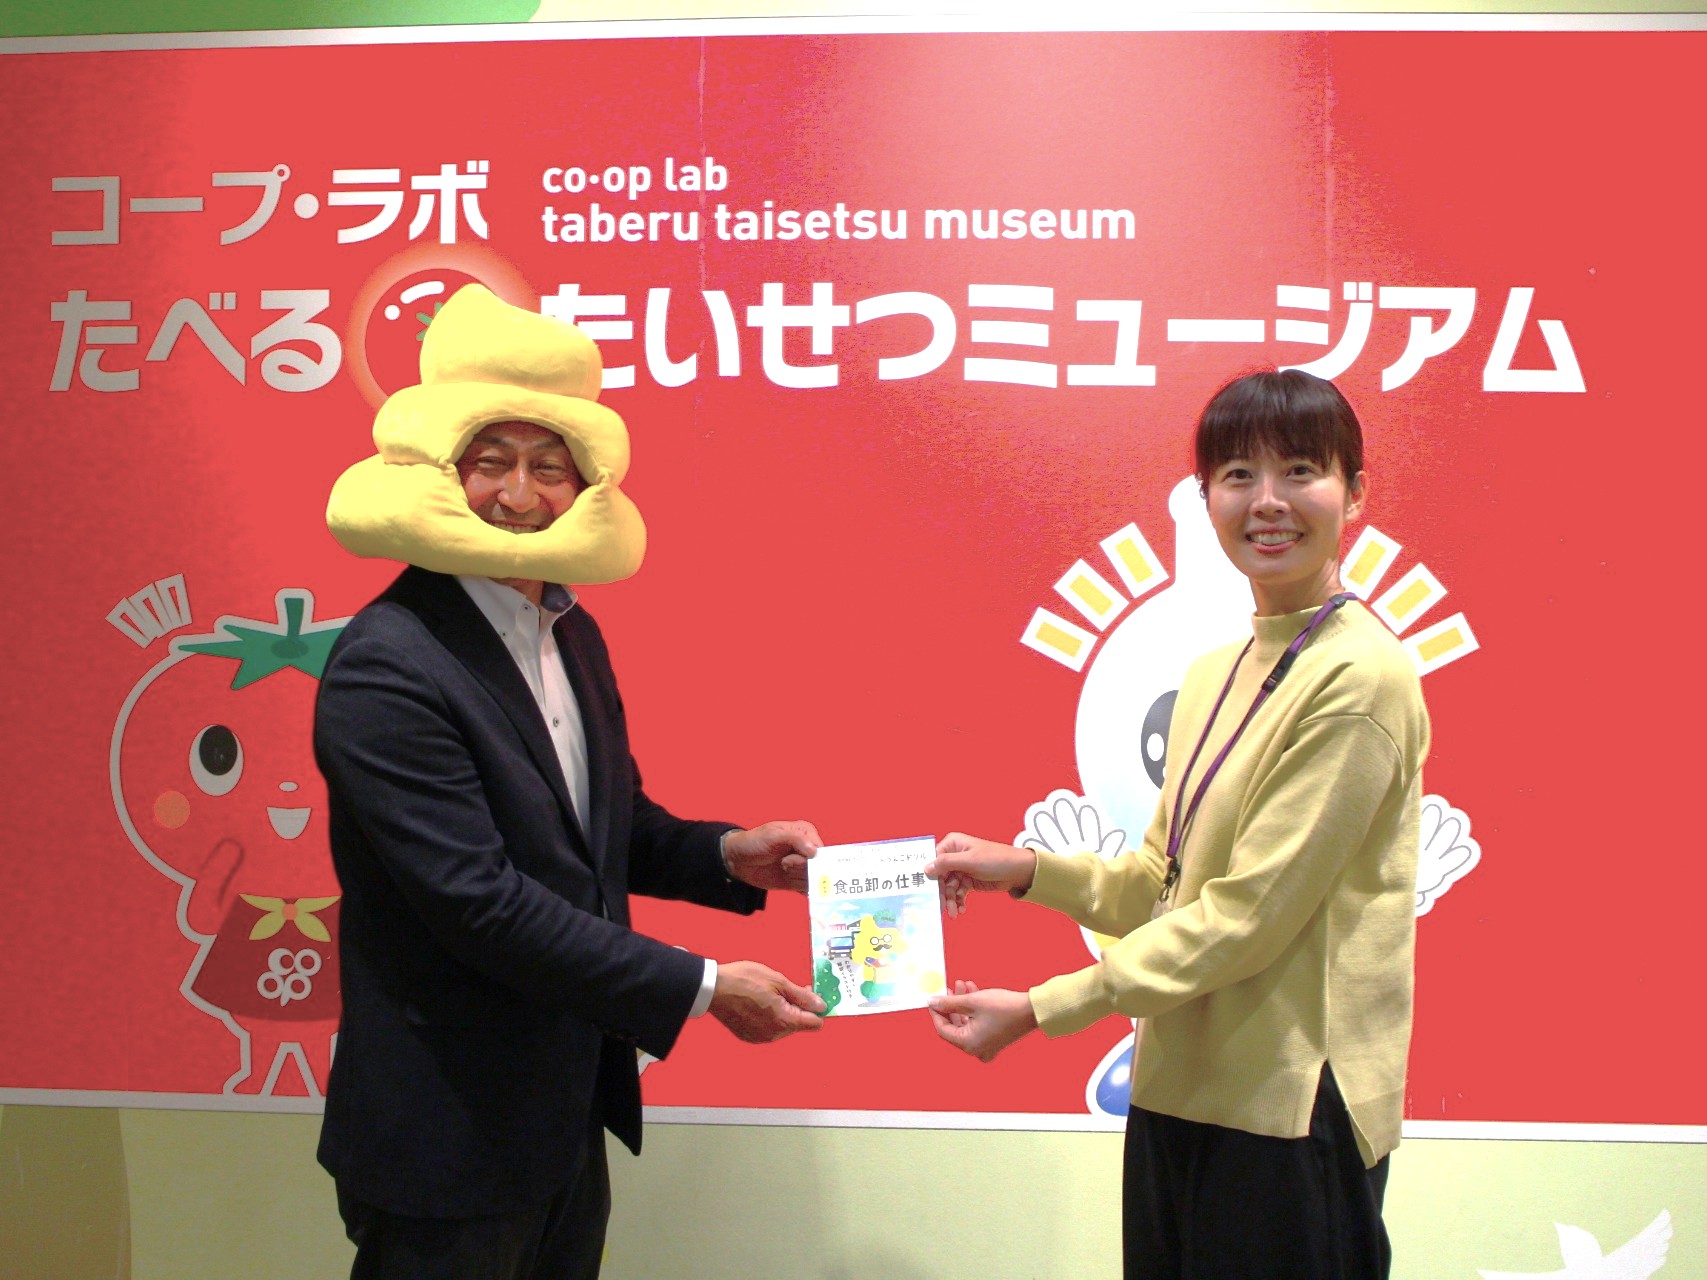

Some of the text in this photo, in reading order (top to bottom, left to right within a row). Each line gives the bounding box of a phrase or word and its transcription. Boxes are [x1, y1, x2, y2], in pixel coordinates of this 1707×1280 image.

[664, 156, 727, 192] lab
[51, 159, 490, 245] コープ・ラボ
[541, 200, 1135, 242] taberu taisetsu museum
[49, 288, 343, 393] たべる
[833, 871, 926, 895] 食品卸の仕事
